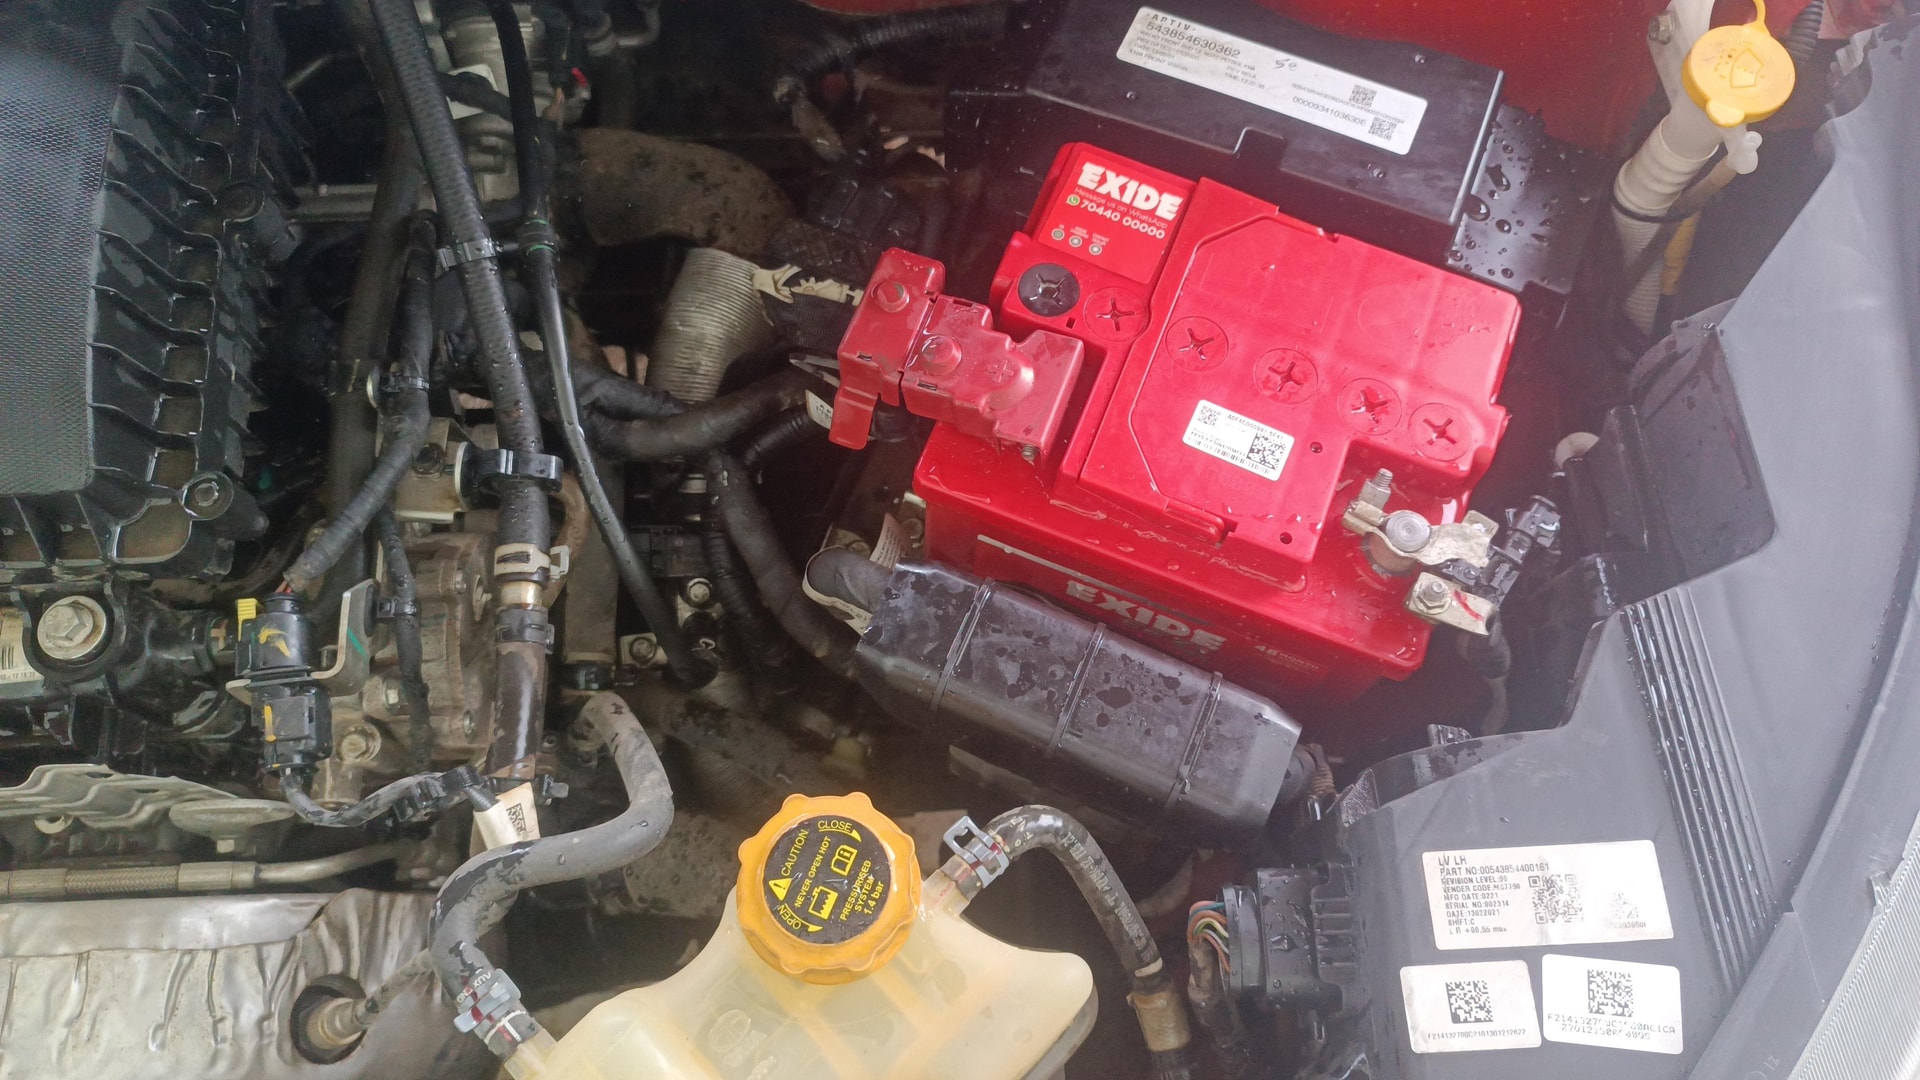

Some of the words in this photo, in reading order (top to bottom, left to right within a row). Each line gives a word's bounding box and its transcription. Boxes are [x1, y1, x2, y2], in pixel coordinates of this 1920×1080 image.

[1146, 21, 1241, 58] 543854630362
[1143, 53, 1166, 64] FRONT
[1167, 61, 1188, 72] VISION
[1074, 187, 1106, 204] Message
[1107, 199, 1116, 208] us
[1117, 203, 1127, 213] on
[1129, 209, 1168, 229] WhatsApp
[1077, 162, 1183, 221] EXIDE
[1080, 200, 1120, 221] 70440
[1122, 216, 1166, 239] 00000
[1065, 580, 1227, 654] EXIDE
[817, 820, 853, 833] CLOSE
[781, 829, 809, 877] CAUTION
[1438, 855, 1450, 866] LV
[1454, 855, 1467, 866] LH
[795, 879, 812, 909] NEVER
[809, 857, 822, 878] OPEN
[818, 836, 832, 857] HOT
[840, 859, 872, 921] PRESSURISED
[1440, 867, 1462, 877] PART
[855, 874, 874, 912] SYSTEM
[864, 898, 875, 915] 1.4
[872, 882, 885, 901] bar
[778, 905, 801, 930] OPEN
[473, 972, 491, 988] AUX
